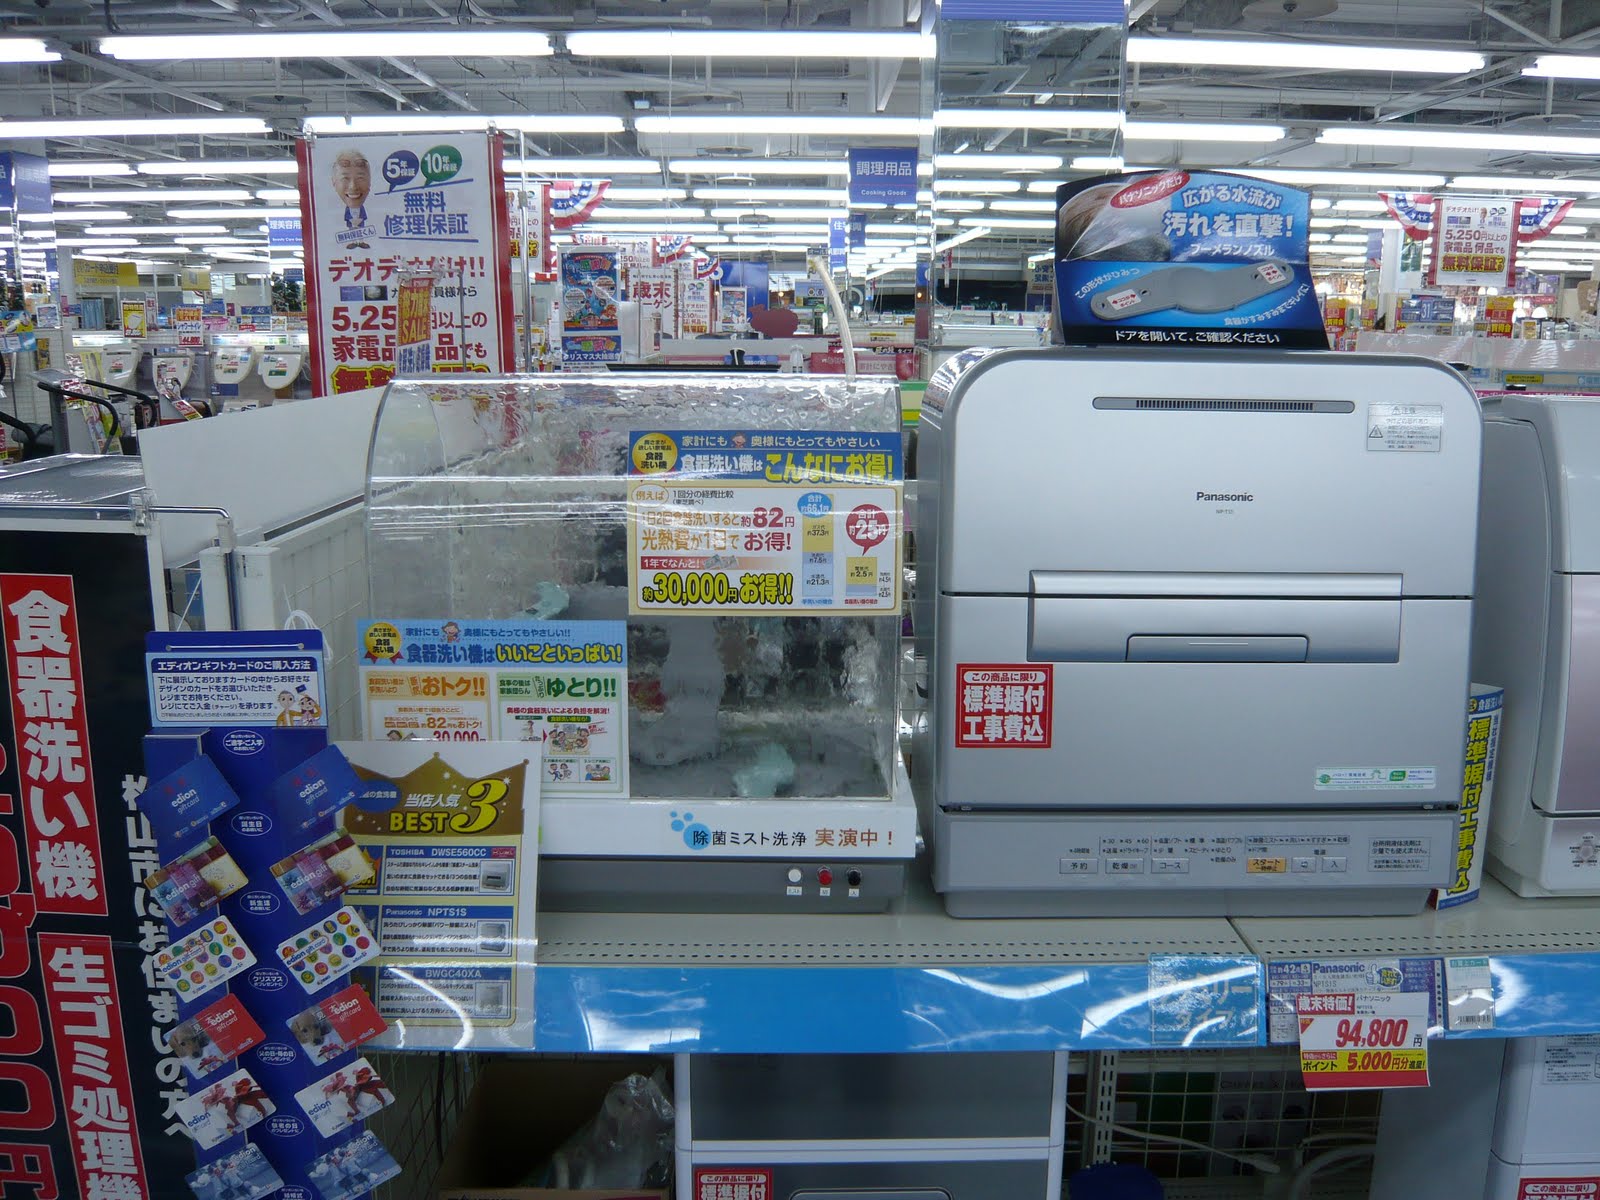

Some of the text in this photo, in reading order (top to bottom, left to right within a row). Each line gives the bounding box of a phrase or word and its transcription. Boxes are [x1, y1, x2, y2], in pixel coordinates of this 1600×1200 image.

[856, 161, 912, 176] 調理用品
[1118, 175, 1183, 206] パナソニックだけ
[1182, 184, 1282, 210] 広がる水流が
[403, 191, 446, 213] 無料
[384, 213, 469, 236] 修理保証
[1163, 212, 1294, 238] 汚れを直撃!
[1445, 229, 1508, 241] 5,250円以上の
[1191, 243, 1275, 257] ブーメランノズル
[632, 281, 672, 299] 歳末
[1074, 267, 1141, 299] この形状がひみつ
[402, 318, 427, 343] SALE
[1115, 330, 1280, 344] ドアを開いて、ご確認ください
[681, 435, 881, 448] 家計にも 奥様にもとってもやさしい
[645, 452, 663, 460] 食器
[641, 461, 667, 469] 洗い機
[636, 490, 734, 500] 例えば 1回分の経費比較
[807, 494, 823, 503] 合計
[1196, 491, 1254, 501] Panasonic
[858, 509, 875, 519] 合計
[644, 557, 700, 569] 1年でなんと!
[405, 627, 571, 638] 家計にも 奥様にもとってもやさしい!!
[375, 638, 391, 646] 食器
[372, 646, 395, 654] 洗い機
[157, 660, 312, 671] エディオンギフトカードのご購入方法
[157, 675, 310, 684] 下に展示しておりますカードの中からお好きな
[499, 679, 531, 687] 食事の後は
[971, 672, 1038, 682] この商品に限り
[158, 684, 277, 692] デザインのカードをお選びいただき、
[422, 676, 486, 697] おトク!!
[499, 687, 531, 695] 家族団らん
[546, 677, 617, 698] ゆとり!!
[160, 693, 243, 701] レジまでお持ちください。
[963, 685, 1045, 714] 標準据付
[963, 714, 1044, 742] 工事費込
[8, 589, 98, 901] 食器洗い機
[299, 778, 326, 798] edion
[171, 788, 197, 808] edion
[404, 793, 462, 807] 当店人気
[389, 778, 510, 834] BEST 3
[692, 830, 808, 847] 除菌ミスト洗浄
[390, 848, 425, 856] TOSHIBA
[431, 848, 487, 857] DWSE560CC
[1070, 862, 1088, 870] 予約
[1159, 862, 1181, 870] コース
[1252, 858, 1281, 866] スタート
[290, 870, 317, 889] edion
[165, 882, 190, 901] edion
[385, 908, 468, 917] Panasonic NPTS1S
[285, 950, 307, 966] edion
[162, 958, 182, 974] edion
[1312, 961, 1366, 974] Panasonic
[425, 969, 482, 978] BWGC40XA
[334, 997, 359, 1015] edion
[211, 1007, 235, 1025] edion
[1335, 1018, 1423, 1048] 94,800 円
[1303, 1060, 1338, 1071] ポイント
[49, 946, 142, 1200] 生ゴミ処理機
[307, 1099, 332, 1116] edion
[187, 1110, 212, 1128] edion
[1531, 1184, 1590, 1193] この商品に限り
